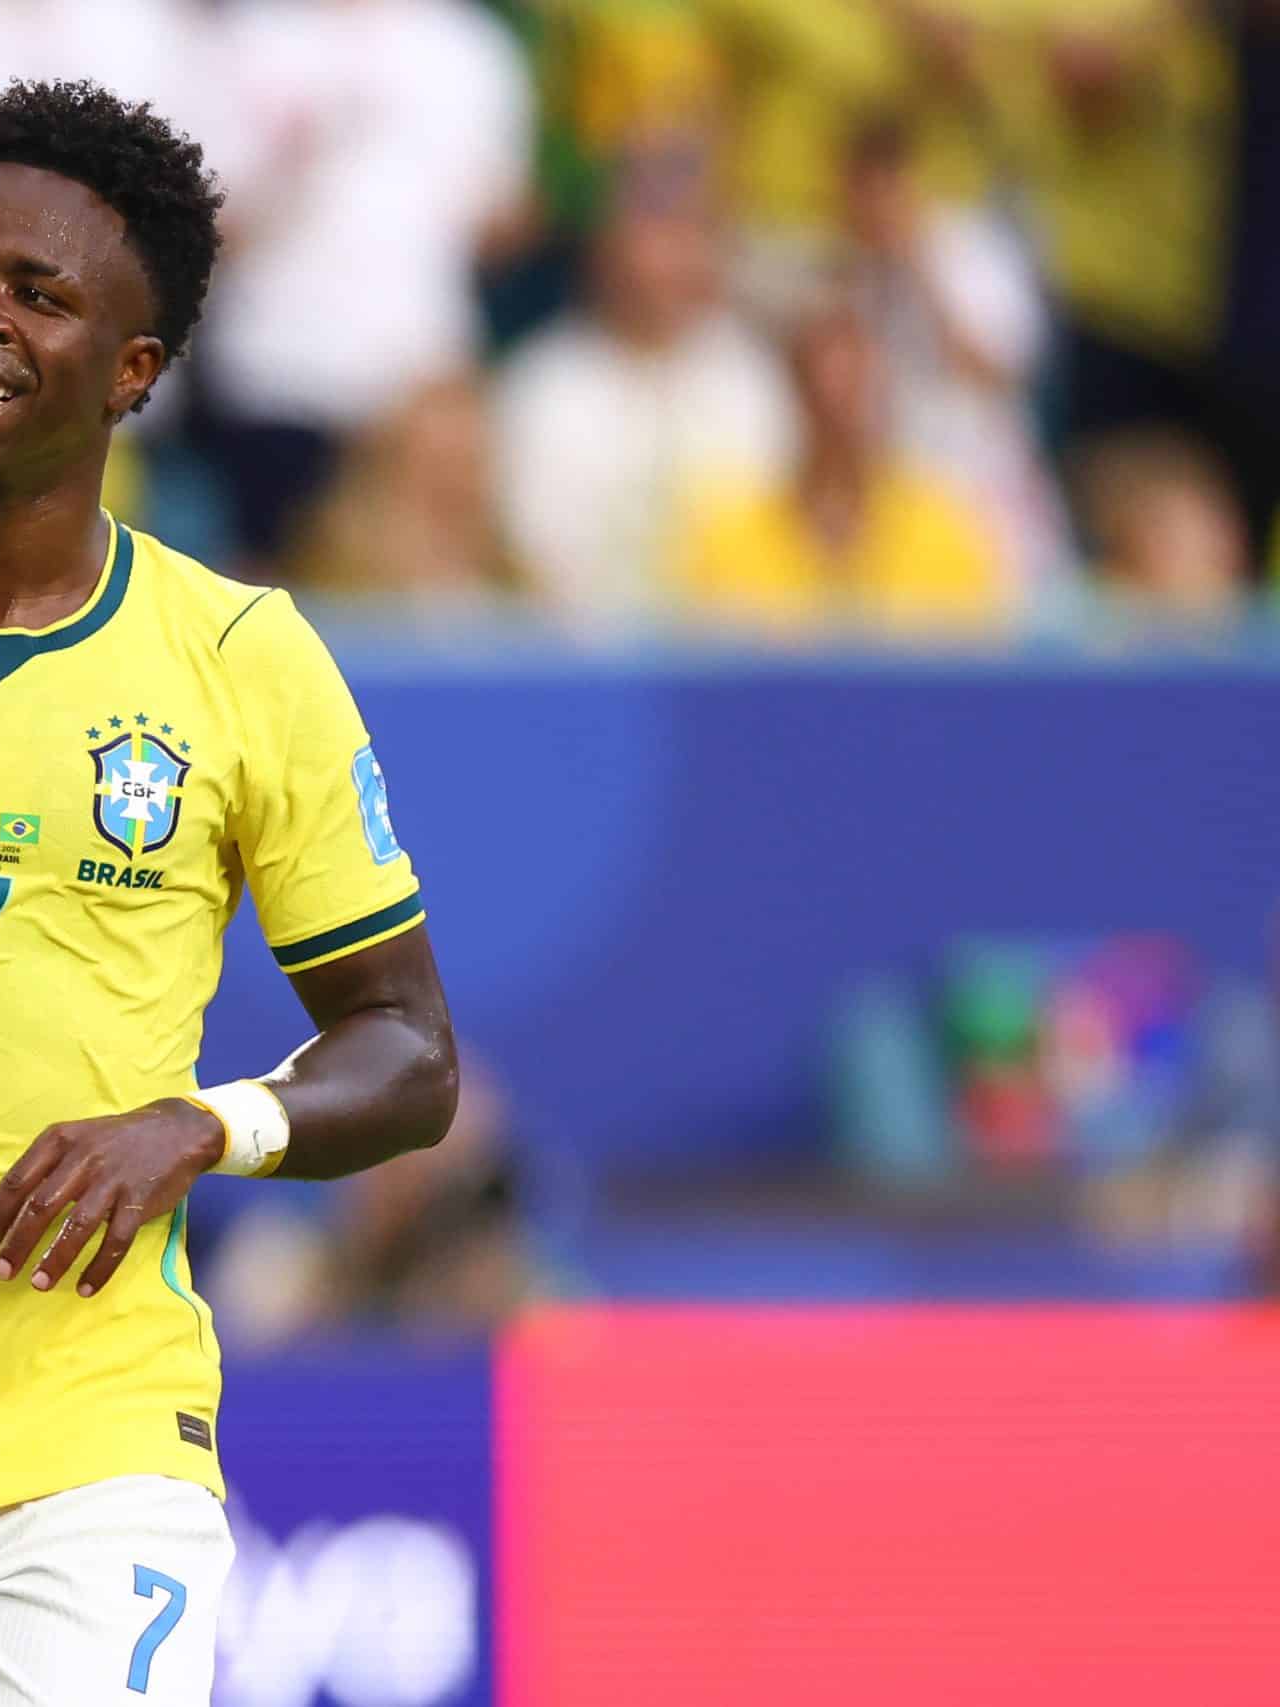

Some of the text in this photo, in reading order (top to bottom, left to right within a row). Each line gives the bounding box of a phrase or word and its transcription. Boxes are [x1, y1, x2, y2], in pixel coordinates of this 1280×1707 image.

[121, 781, 156, 799] CBF
[77, 859, 165, 889] BRASIL
[126, 1563, 187, 1694] 7
